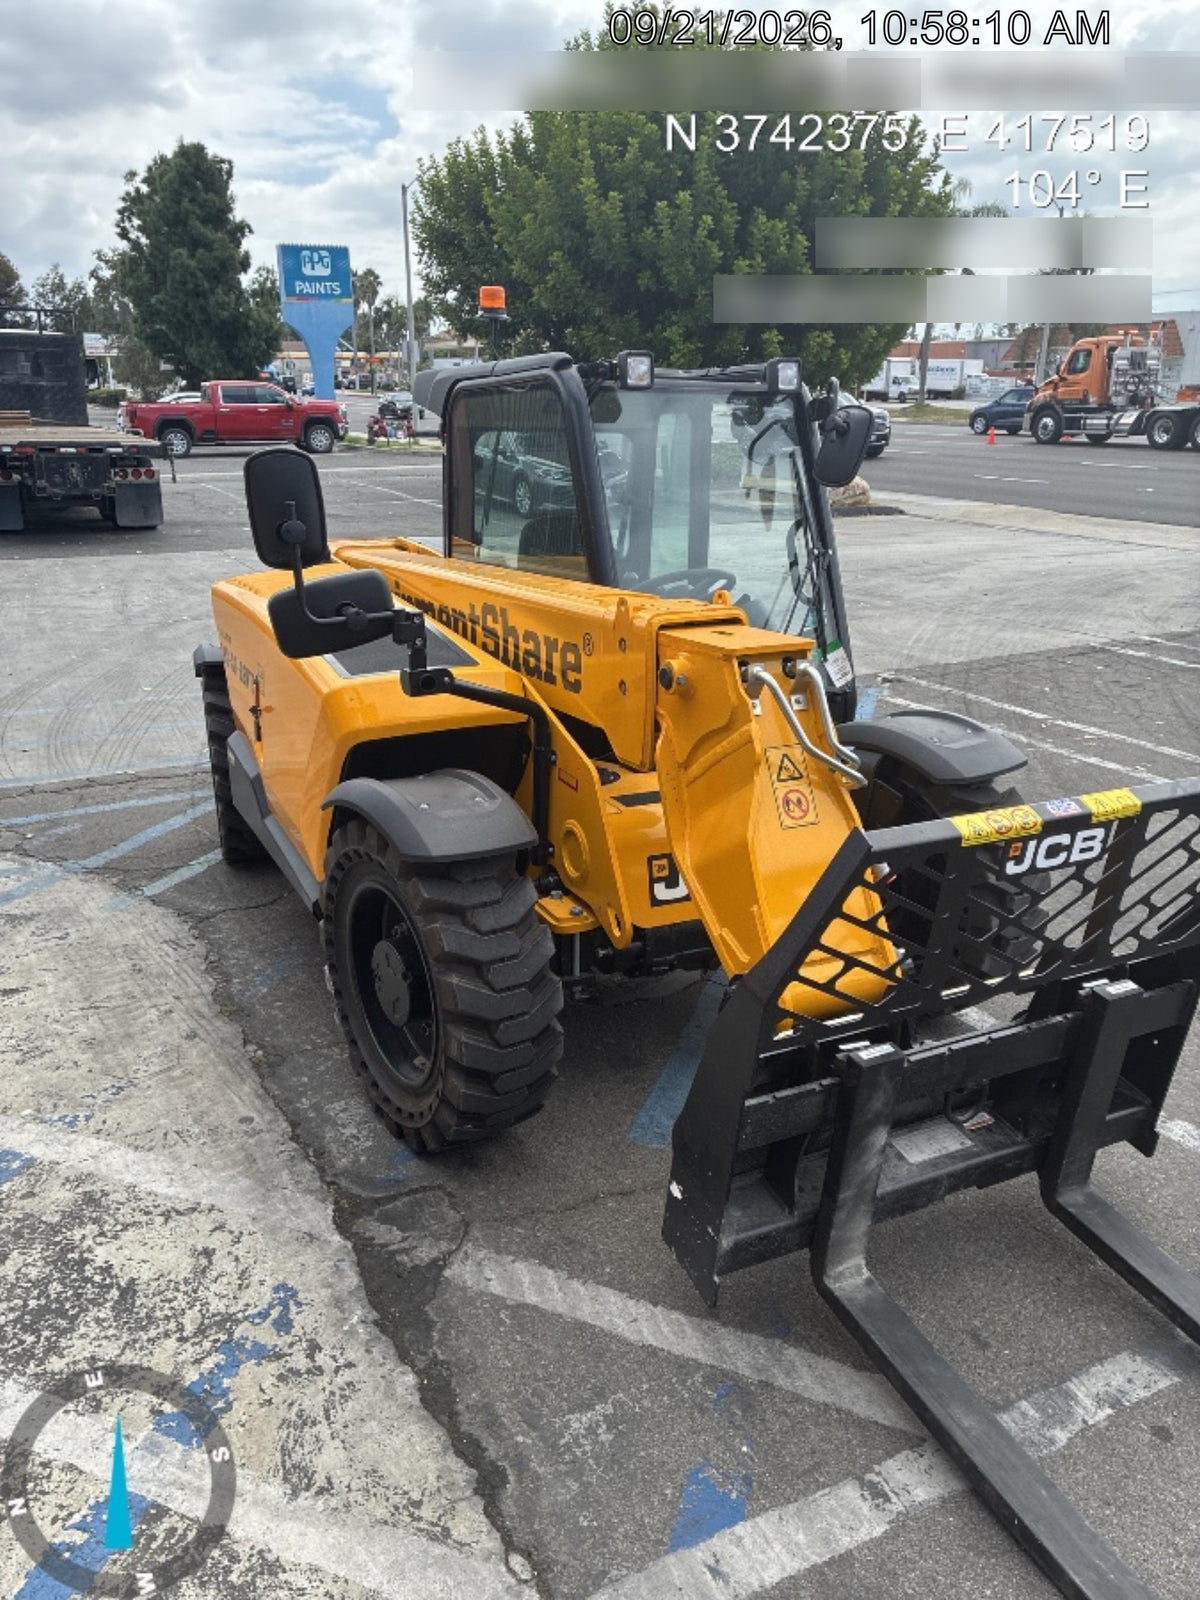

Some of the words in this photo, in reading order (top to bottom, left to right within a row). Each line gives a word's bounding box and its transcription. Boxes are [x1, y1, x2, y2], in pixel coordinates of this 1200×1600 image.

[303, 251, 330, 272] PPG
[295, 281, 341, 294] PAINTS
[1005, 828, 1106, 875] JCB
